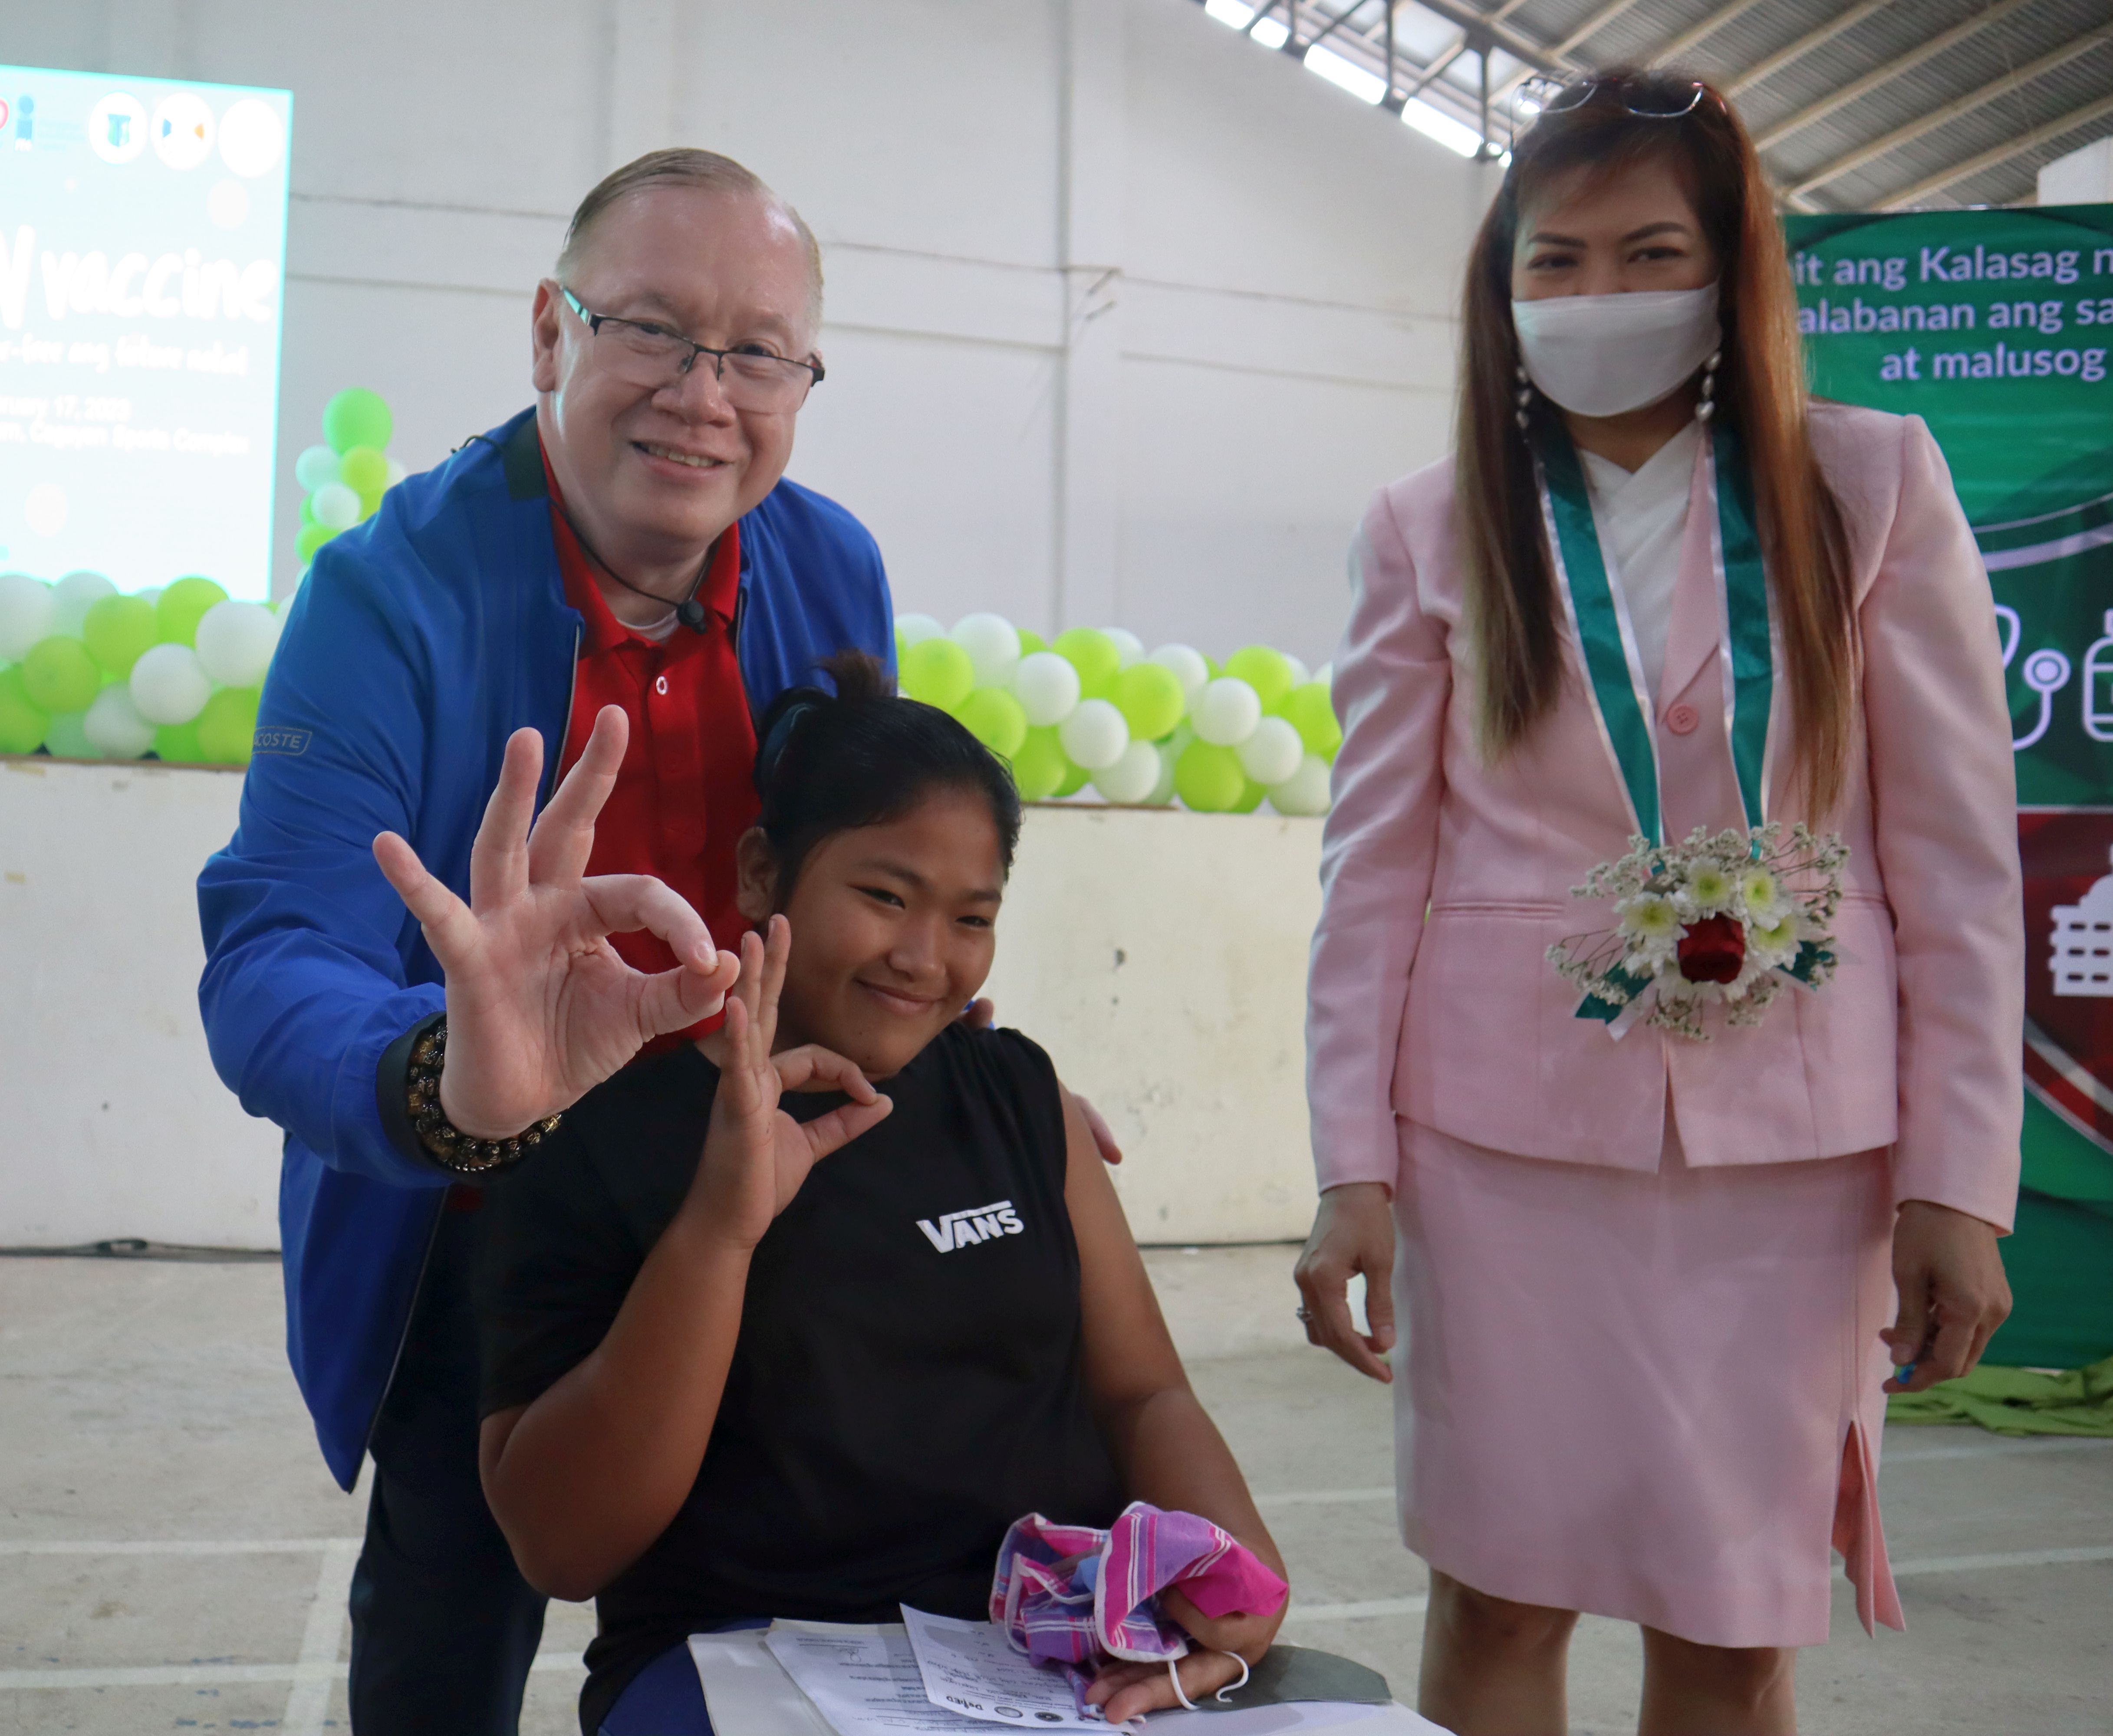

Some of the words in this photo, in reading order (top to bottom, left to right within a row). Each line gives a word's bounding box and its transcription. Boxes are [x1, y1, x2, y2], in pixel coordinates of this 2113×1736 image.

[41, 248, 277, 321] vaccine
[1833, 257, 1907, 291] ang
[1919, 244, 2080, 284] Kalasag
[1988, 300, 2064, 334] ang
[2076, 298, 2113, 325] sa
[1879, 347, 1922, 381] at
[1932, 342, 2107, 382] malusog
[915, 1200, 1025, 1253] VANS
